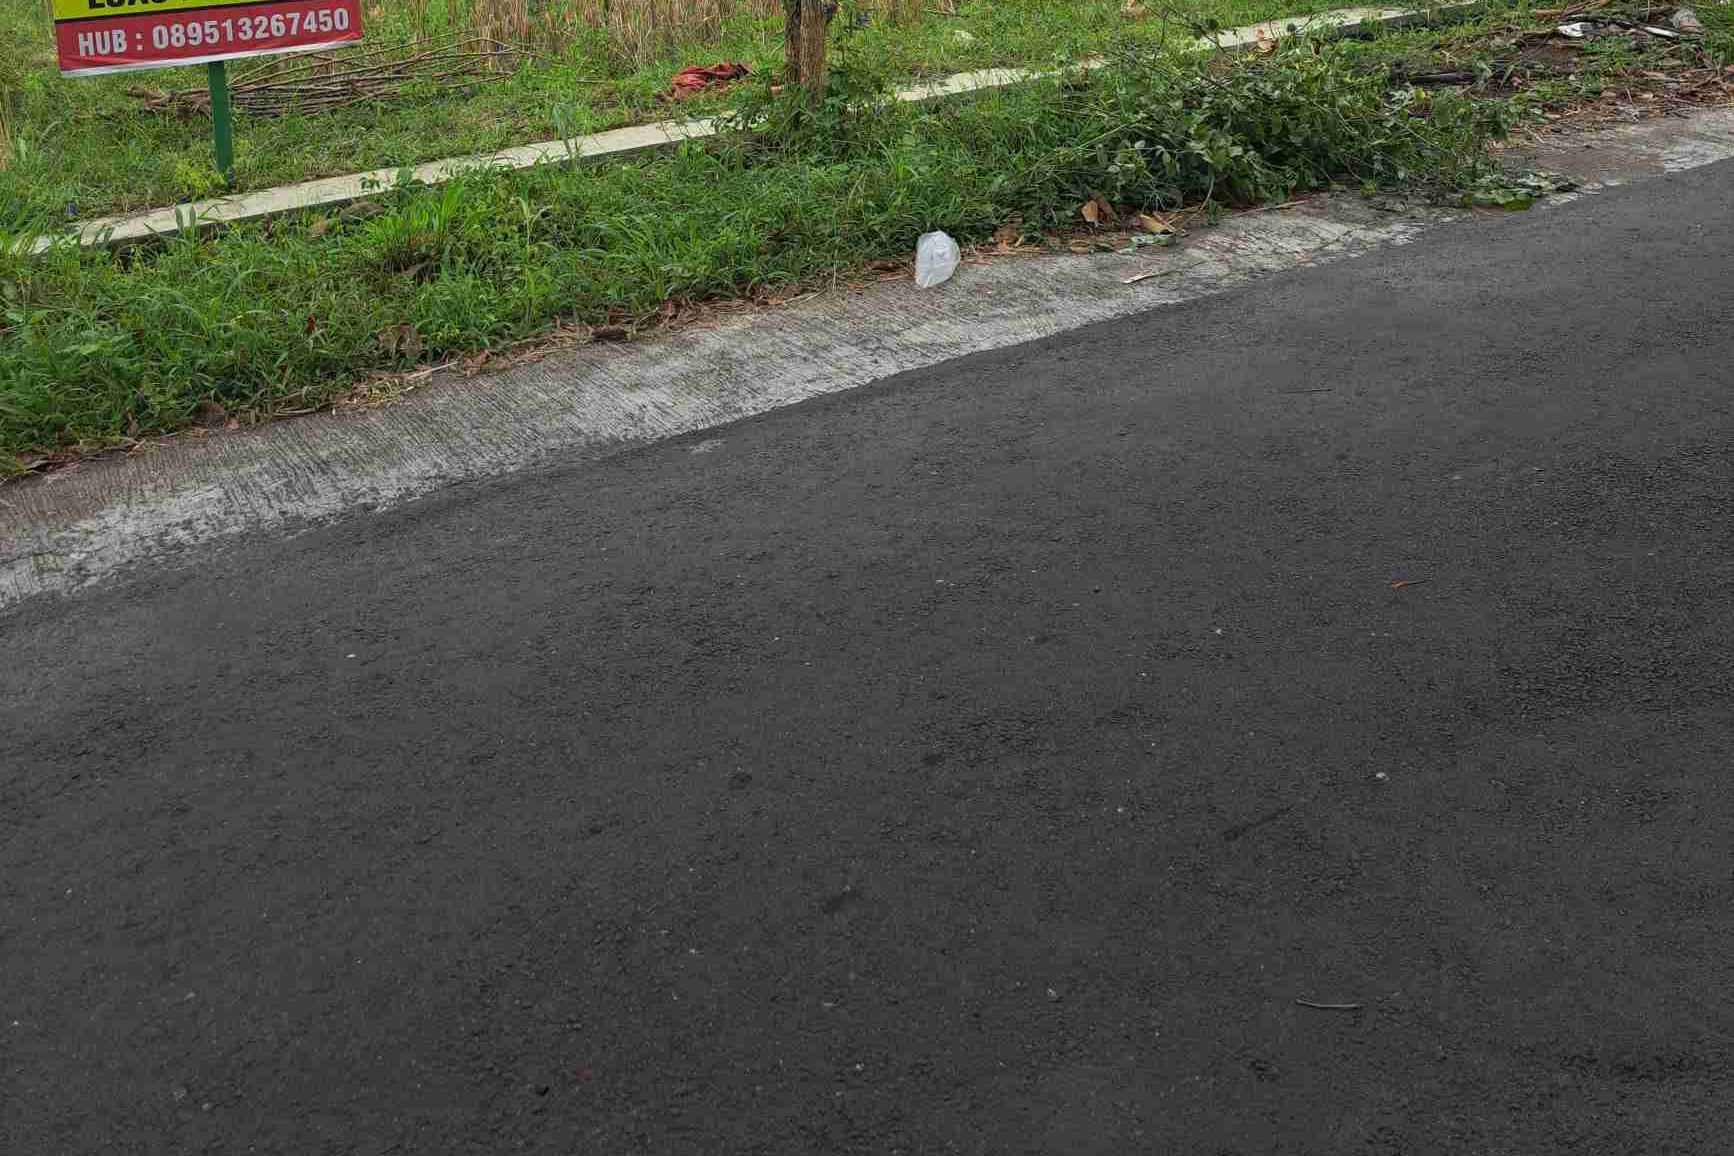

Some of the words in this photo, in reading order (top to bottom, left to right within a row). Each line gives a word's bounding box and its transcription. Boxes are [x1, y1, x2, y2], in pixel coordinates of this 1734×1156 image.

[77, 30, 128, 56] HUB
[135, 33, 144, 50] :
[151, 7, 350, 50] 089513267450
